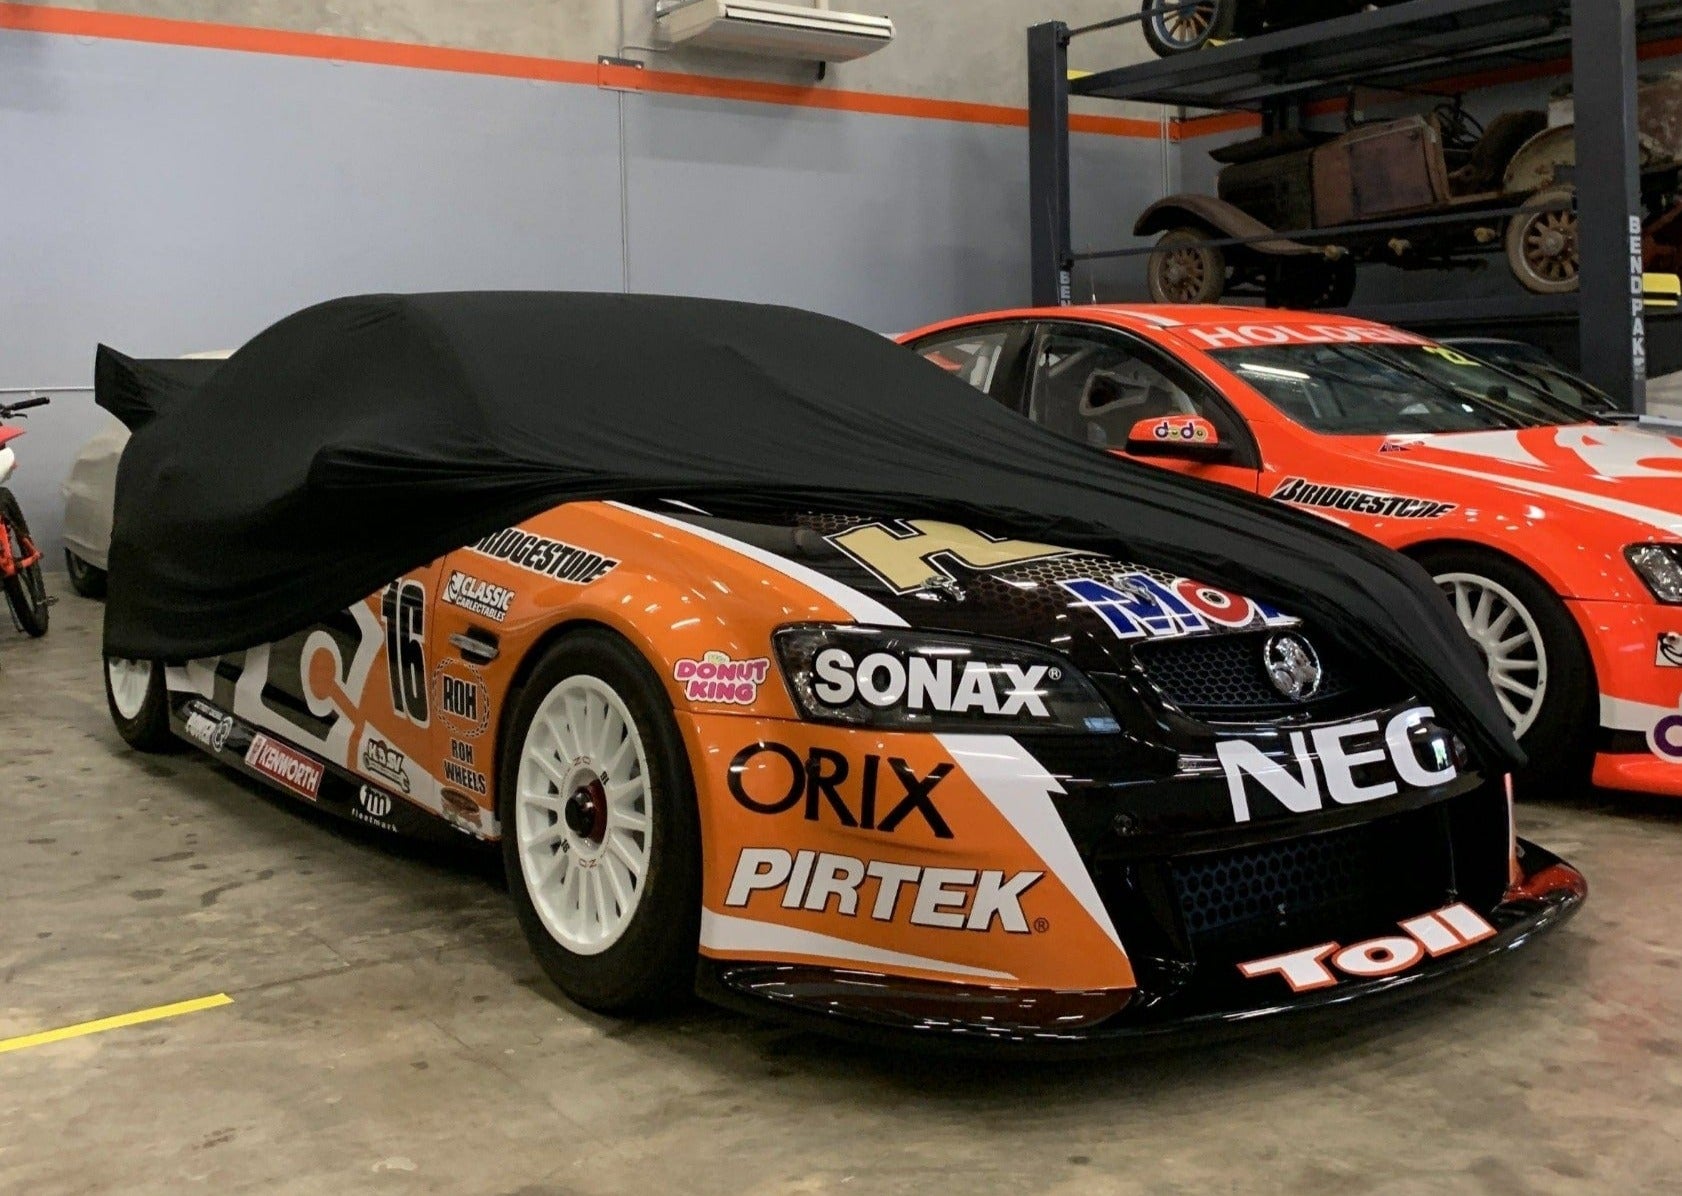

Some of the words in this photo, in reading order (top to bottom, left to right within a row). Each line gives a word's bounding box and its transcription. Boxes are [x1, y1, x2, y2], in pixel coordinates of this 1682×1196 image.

[1271, 478, 1456, 518] BRIDGESTONE
[455, 595, 507, 622] CARLECTABLES
[461, 576, 515, 612] CLASSIC
[382, 579, 430, 727] 16
[677, 660, 768, 681] DONUT
[443, 674, 479, 721] ROH
[689, 681, 754, 702] KING
[259, 744, 320, 793] KENWORTH
[451, 738, 475, 765] ROH
[1215, 706, 1457, 823] NEC
[444, 759, 487, 796] WHEELS
[727, 741, 955, 839] ORIX
[724, 848, 1046, 934] PIRTEK
